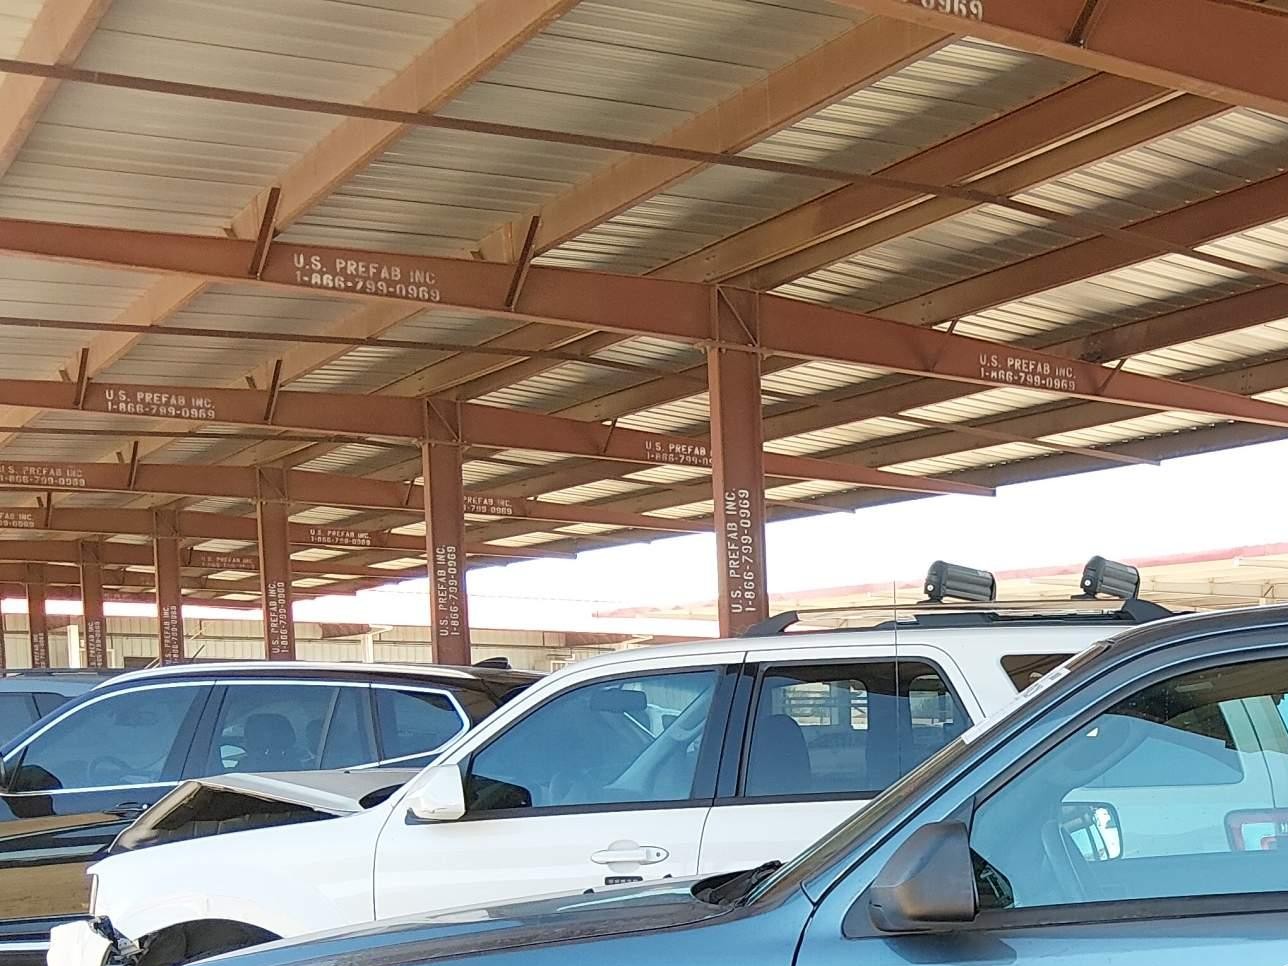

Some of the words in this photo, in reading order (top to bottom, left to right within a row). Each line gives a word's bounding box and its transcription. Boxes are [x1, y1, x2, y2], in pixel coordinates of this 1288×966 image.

[293, 253, 327, 272] U.S.
[335, 258, 401, 281] PREFAB
[295, 270, 441, 302] 1-866-799-0969
[980, 353, 1001, 368] U.S.
[1007, 357, 1050, 375] PREFAB
[1055, 367, 1076, 379] INC.
[980, 367, 1076, 391] 1-866-799-0969
[137, 391, 186, 406] PREFAB
[668, 443, 706, 456] PREFAB
[725, 488, 737, 515] INC.
[727, 522, 741, 578] PREFAB
[738, 489, 756, 612] 1-866-799-0969
[436, 569, 448, 610] PREFAB
[447, 546, 460, 636] 1-866-799-0969
[731, 586, 743, 613] U.S.
